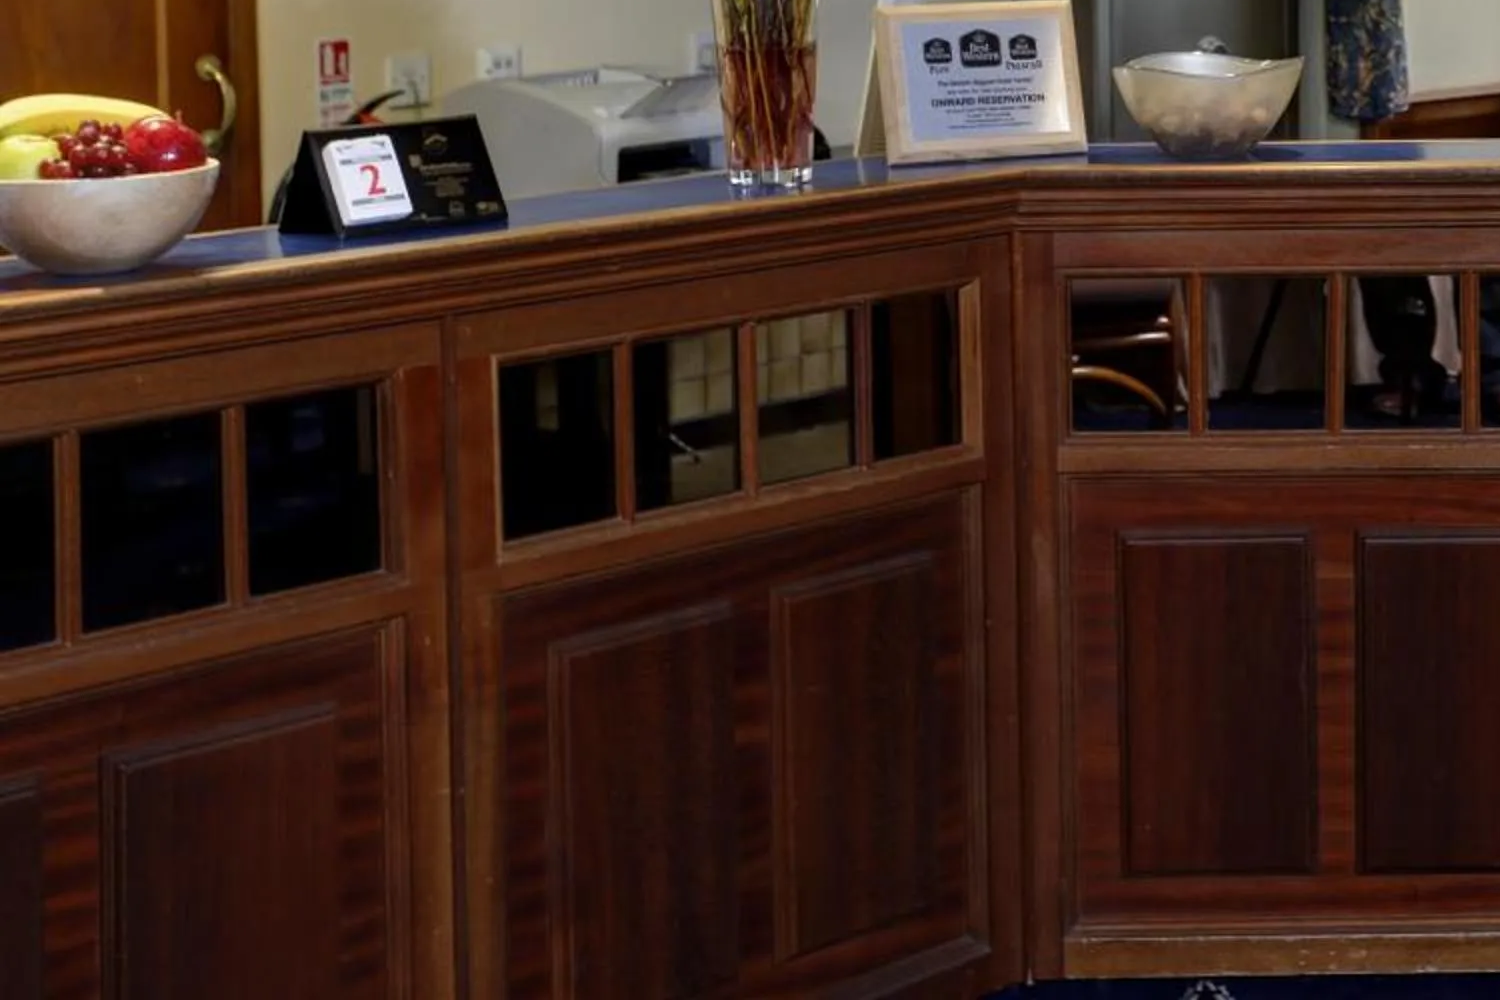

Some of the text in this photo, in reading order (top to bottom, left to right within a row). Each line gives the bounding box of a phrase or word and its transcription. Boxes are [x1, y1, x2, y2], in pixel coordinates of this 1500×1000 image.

[969, 42, 990, 52] Best
[962, 51, 999, 62] Western
[931, 93, 1045, 108] ONWARD RESERVATION
[359, 164, 387, 197] 2
